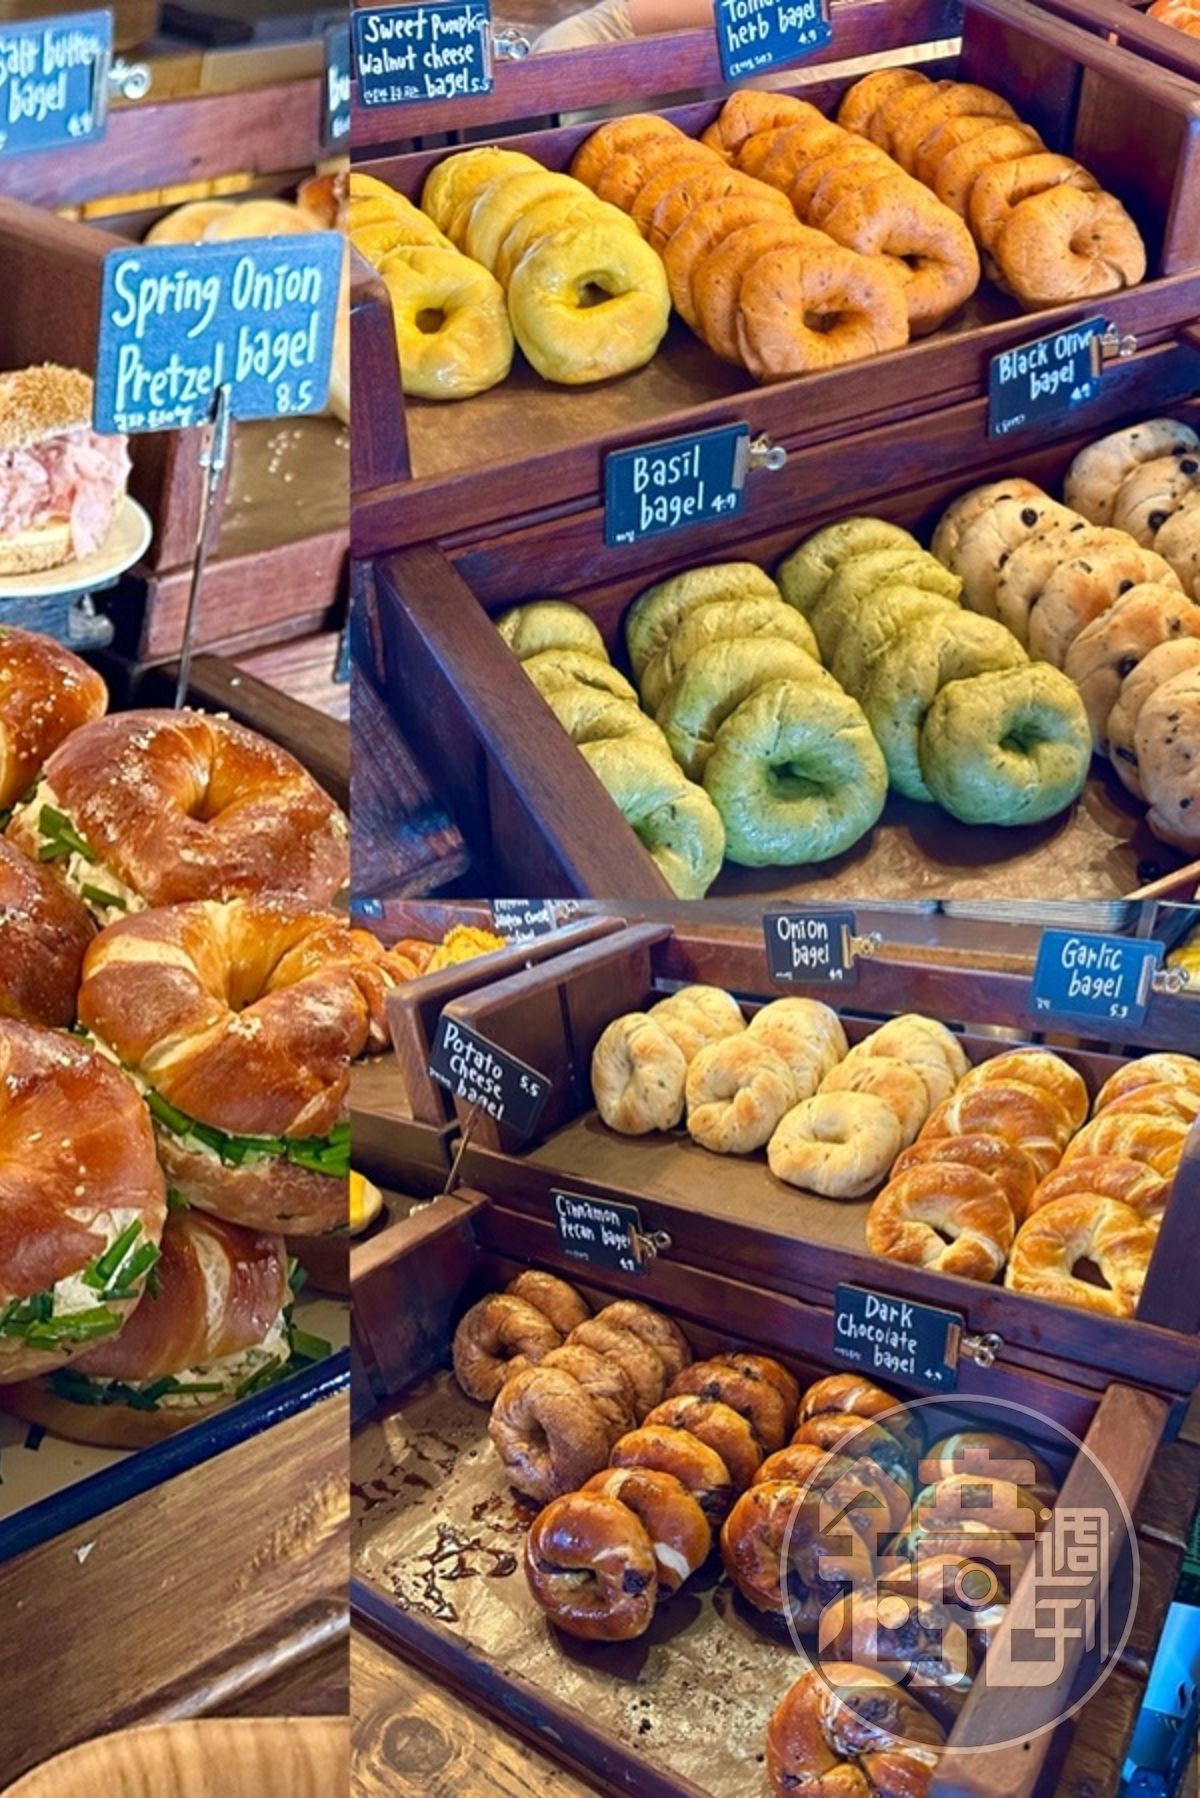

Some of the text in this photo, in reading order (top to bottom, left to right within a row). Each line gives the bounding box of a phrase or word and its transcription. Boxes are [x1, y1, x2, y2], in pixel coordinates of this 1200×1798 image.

[365, 8, 427, 43] Sweet
[726, 0, 816, 52] herb bagel
[358, 43, 474, 76] Walnut cheese
[8, 71, 69, 123] bagel
[424, 67, 469, 98] bagel
[111, 257, 323, 338] Spring Onion
[115, 311, 320, 412] Pretzel bagel
[999, 342, 1048, 384] Black
[275, 380, 314, 413] 8.5
[1029, 359, 1074, 400] bagel
[633, 444, 700, 494] Basil
[641, 481, 704, 531] bagel
[777, 916, 829, 941] Onion
[791, 940, 829, 968] bagel
[1061, 938, 1122, 971] Garlic
[1068, 969, 1123, 999] bagel
[443, 1021, 503, 1079] Potato
[450, 1055, 502, 1100] Cheese
[519, 1075, 541, 1097] 5.5
[556, 1195, 620, 1226] Cinnamon
[865, 1294, 914, 1328] Dark
[837, 1313, 918, 1354] Chocolate
[873, 1344, 915, 1374] bagel
